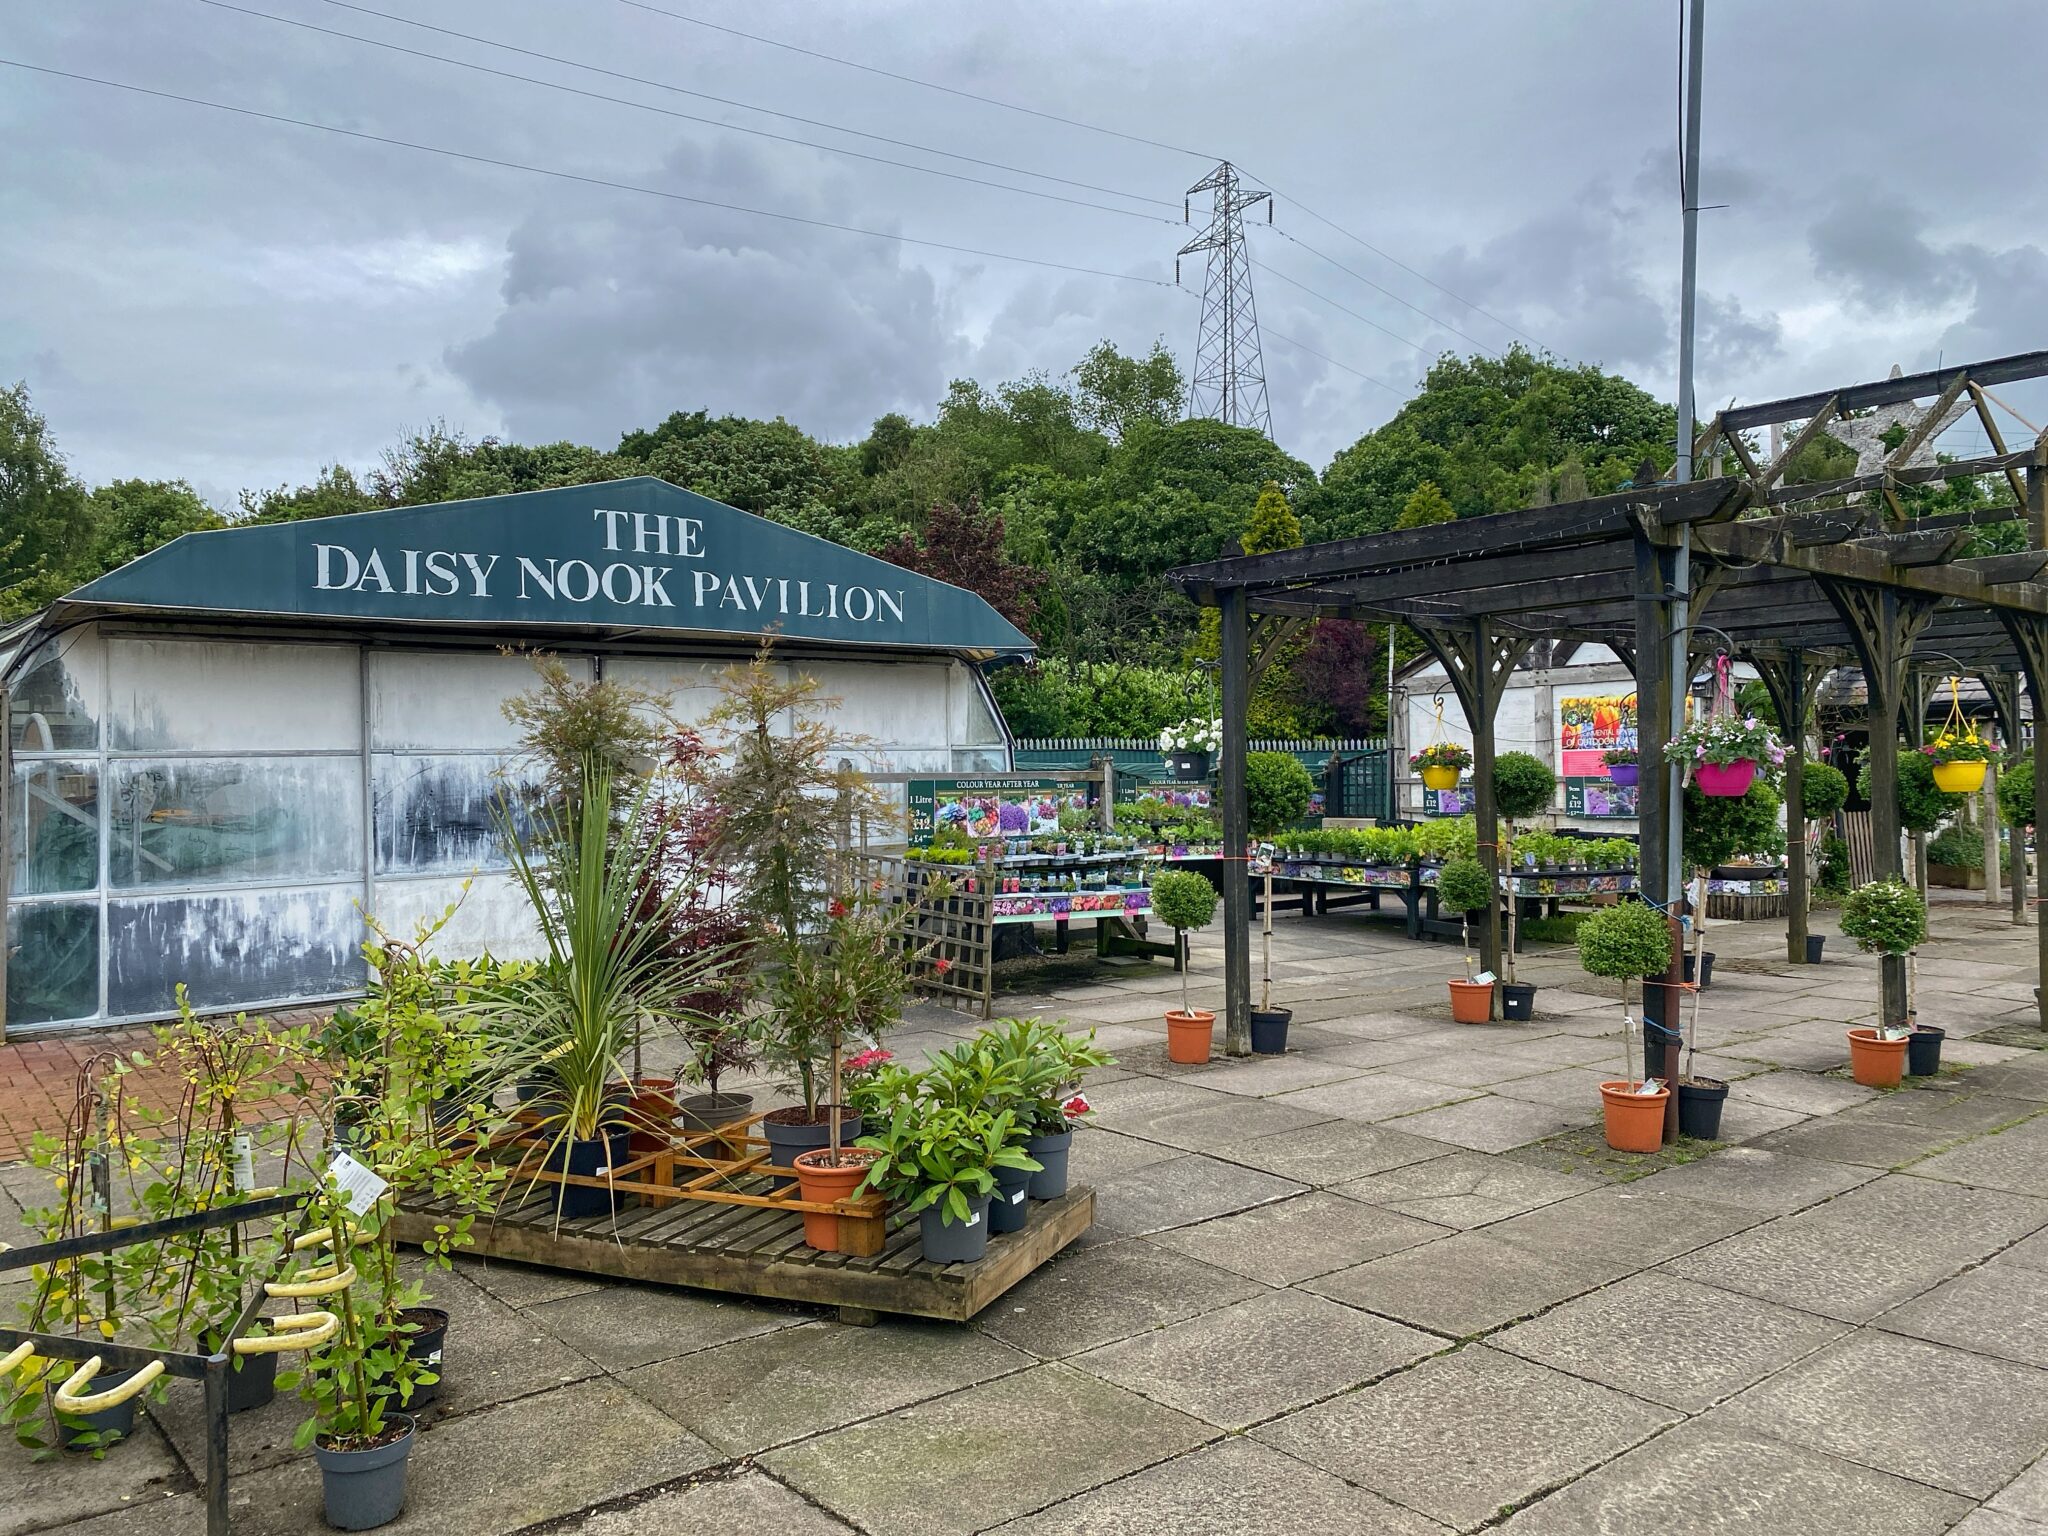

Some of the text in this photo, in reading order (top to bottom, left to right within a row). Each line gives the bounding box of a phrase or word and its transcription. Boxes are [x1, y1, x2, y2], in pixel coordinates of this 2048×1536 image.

[594, 509, 705, 558] THE
[312, 543, 905, 623] DAISY NOOK PAVILION
[1577, 738, 1615, 746] OUTDOOR
[956, 780, 1040, 789] COLOUR YEAR AFTER YEAR
[909, 795, 933, 804] 1 Litre
[915, 809, 920, 817] 3
[912, 818, 931, 830] £12
